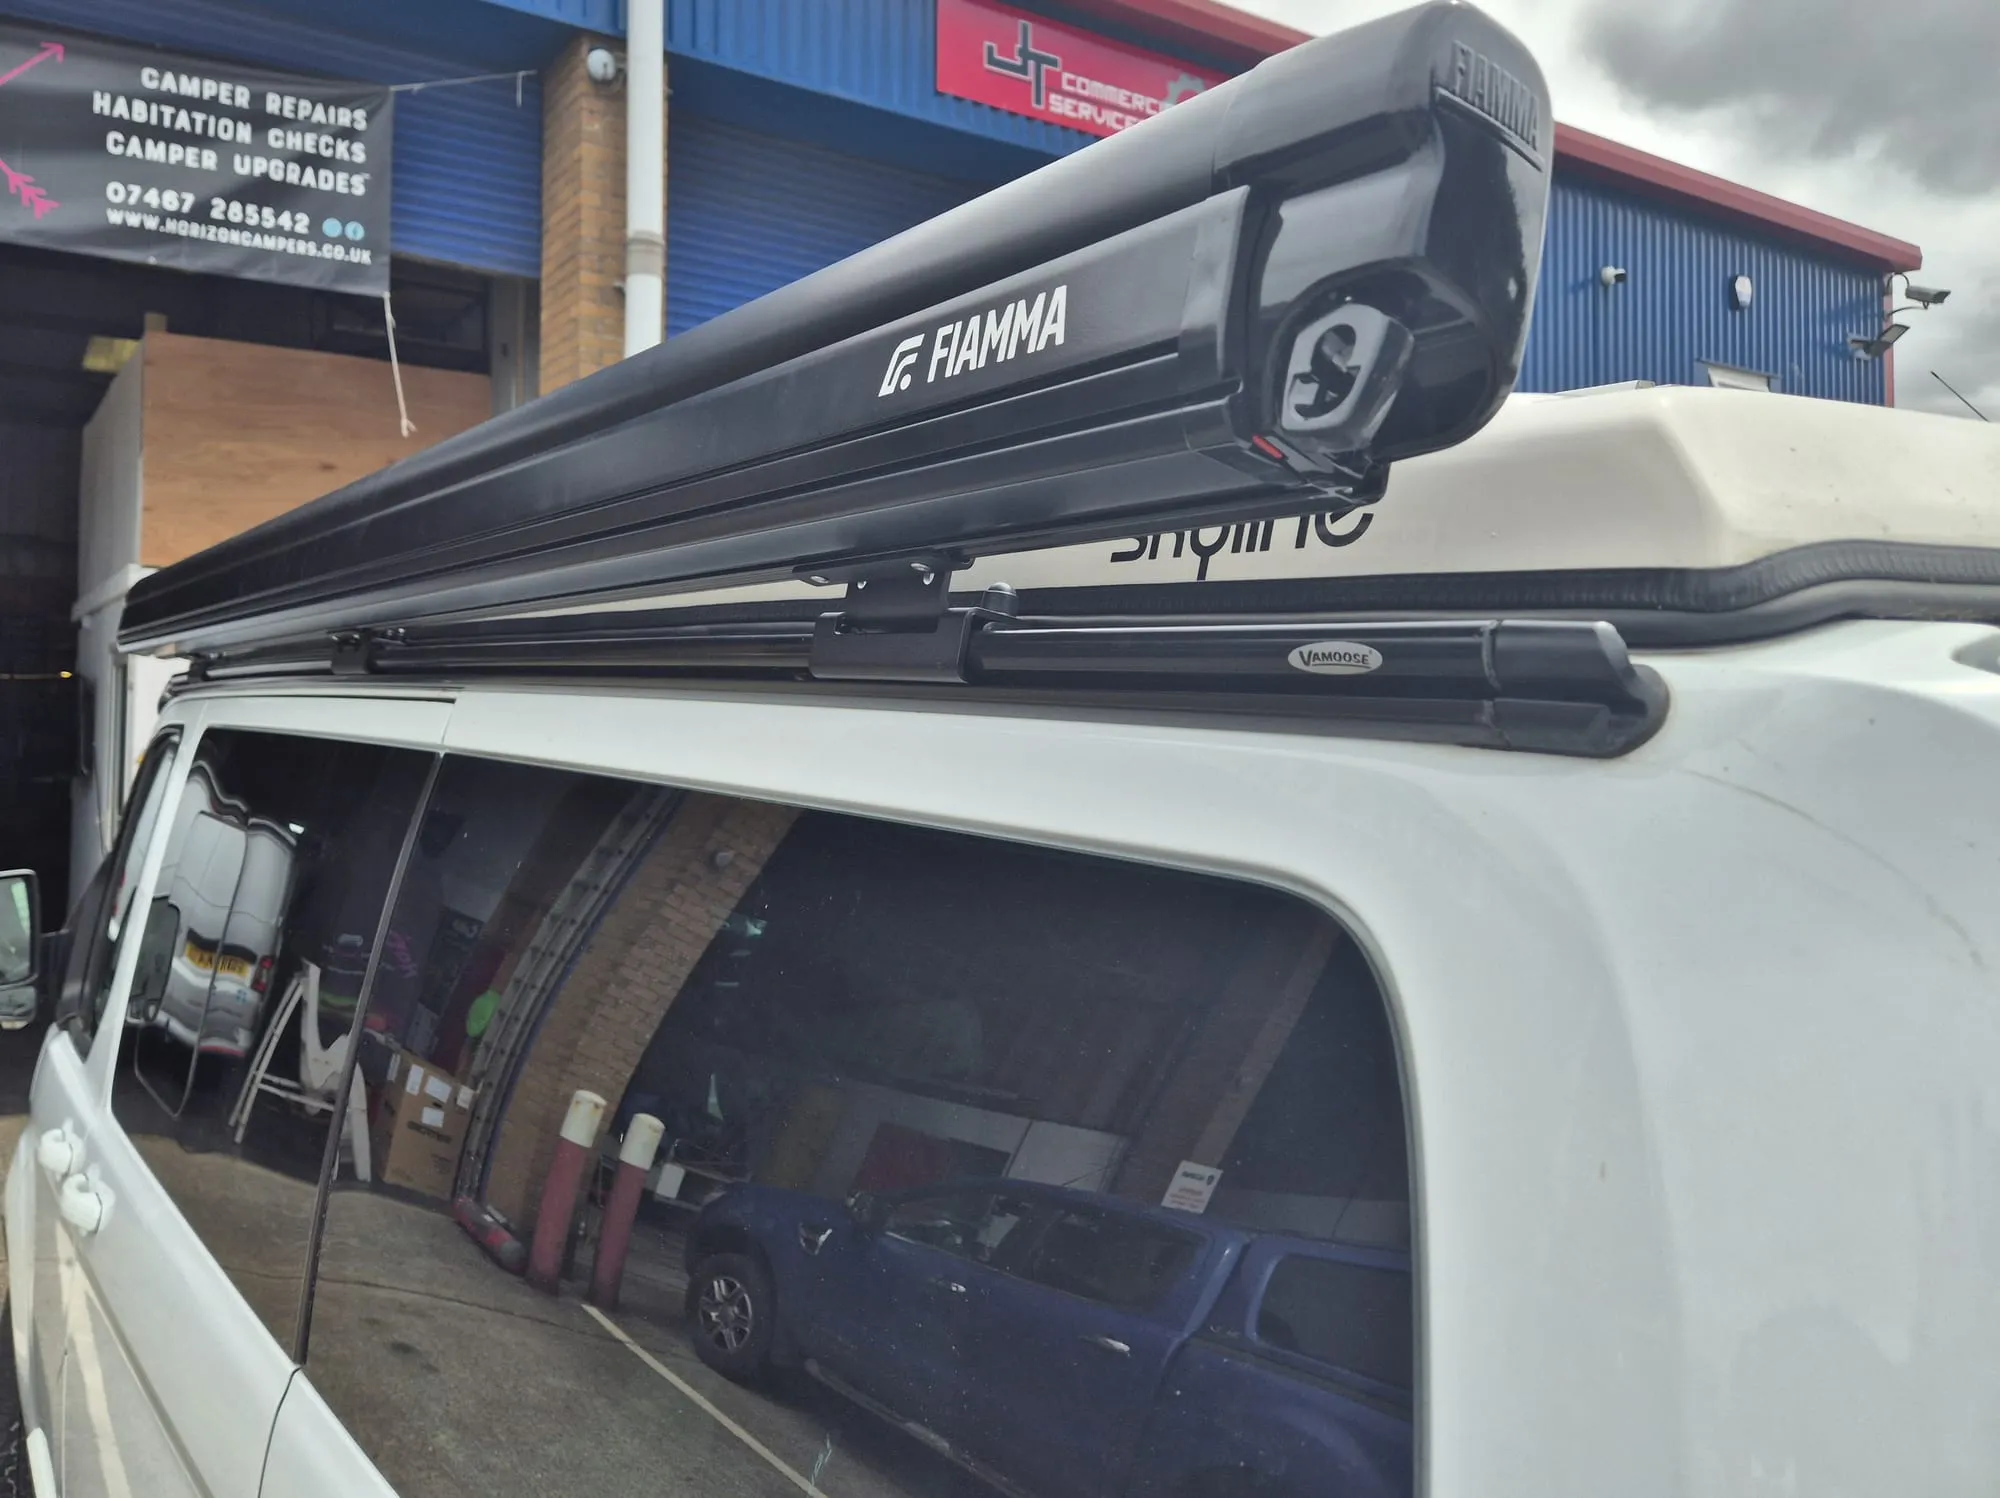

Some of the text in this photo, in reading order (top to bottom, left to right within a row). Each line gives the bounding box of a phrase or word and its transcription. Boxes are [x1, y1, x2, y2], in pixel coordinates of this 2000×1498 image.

[141, 66, 367, 131] CAMPER REPAIRS
[1061, 71, 1175, 114] COMMERCI
[1451, 38, 1540, 151] FIAMMA
[92, 90, 366, 164] HABITATION CHECKS
[105, 130, 366, 196] CAMPER UPGRADES
[105, 181, 310, 234] 07467 285542
[106, 207, 372, 265] WWW.HORIZONCAMPERS.CO.UK
[927, 285, 1067, 383] FIAMMA
[1299, 649, 1370, 667] VAMOOSE
